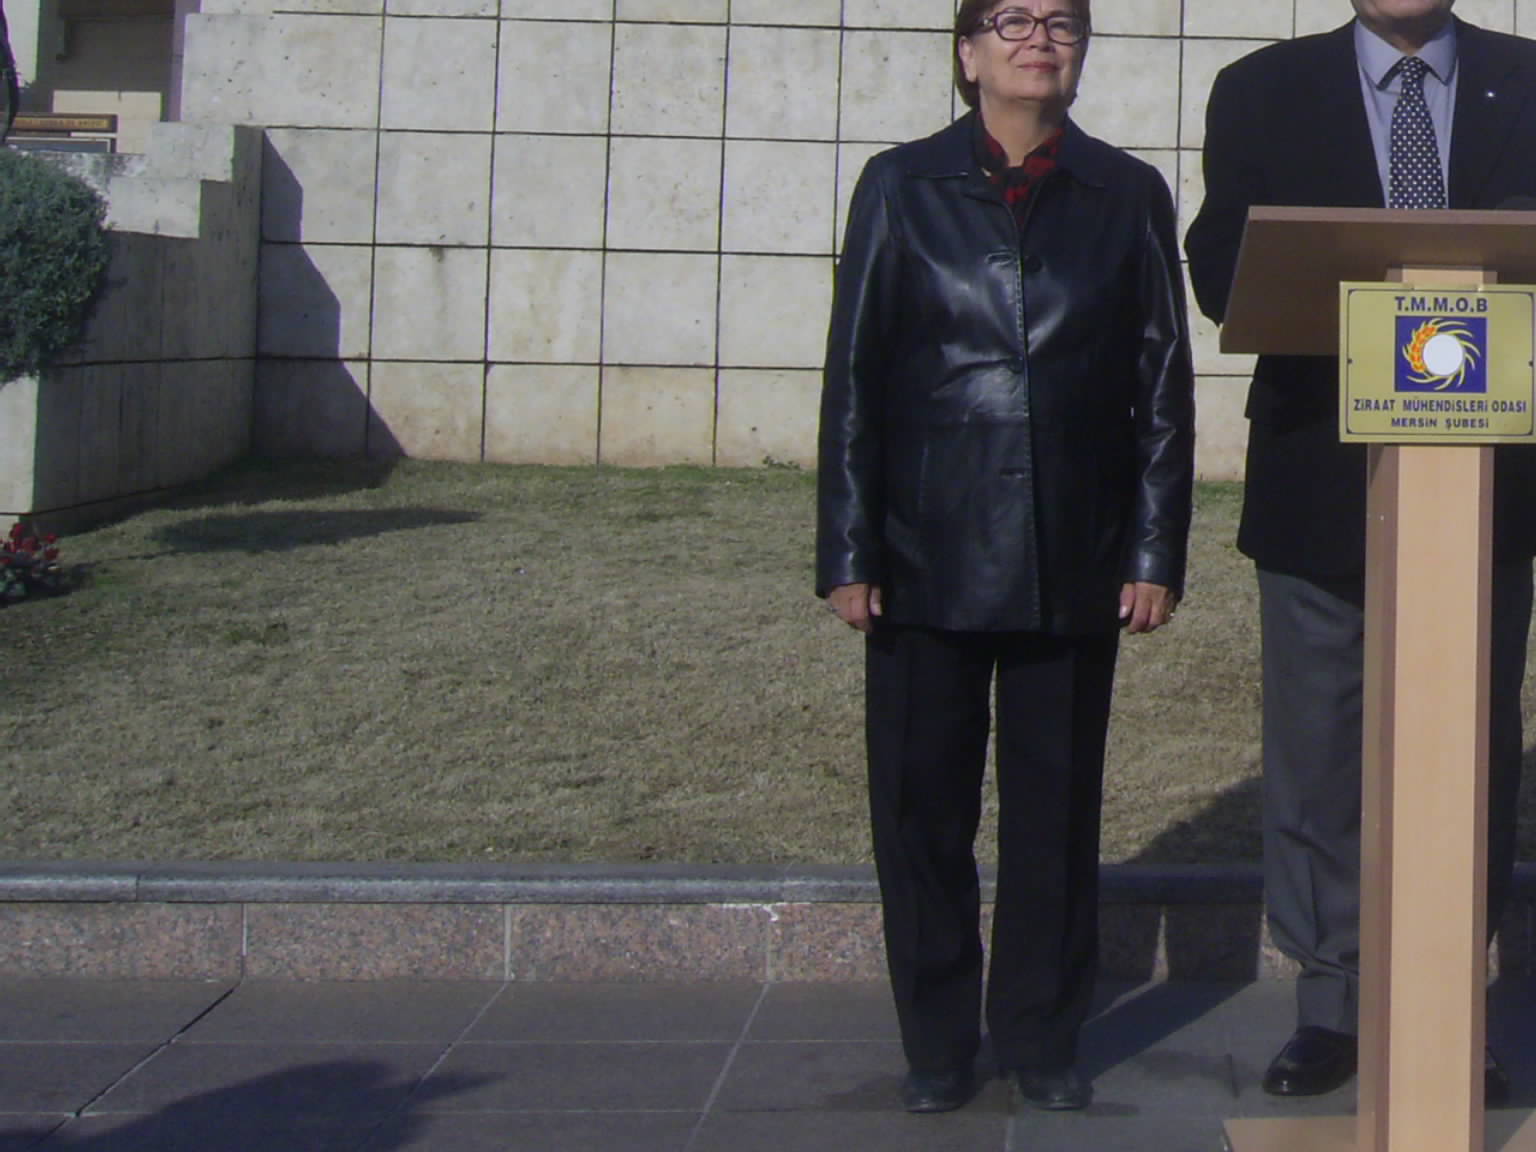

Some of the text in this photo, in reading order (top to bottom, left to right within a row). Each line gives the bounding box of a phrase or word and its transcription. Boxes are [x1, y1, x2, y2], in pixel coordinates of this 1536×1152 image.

[1394, 296, 1489, 313] T.M.M.O.B
[1353, 399, 1396, 412] ZİRAAT
[1491, 400, 1527, 413] ODASI
[1391, 417, 1438, 428] MERSİN
